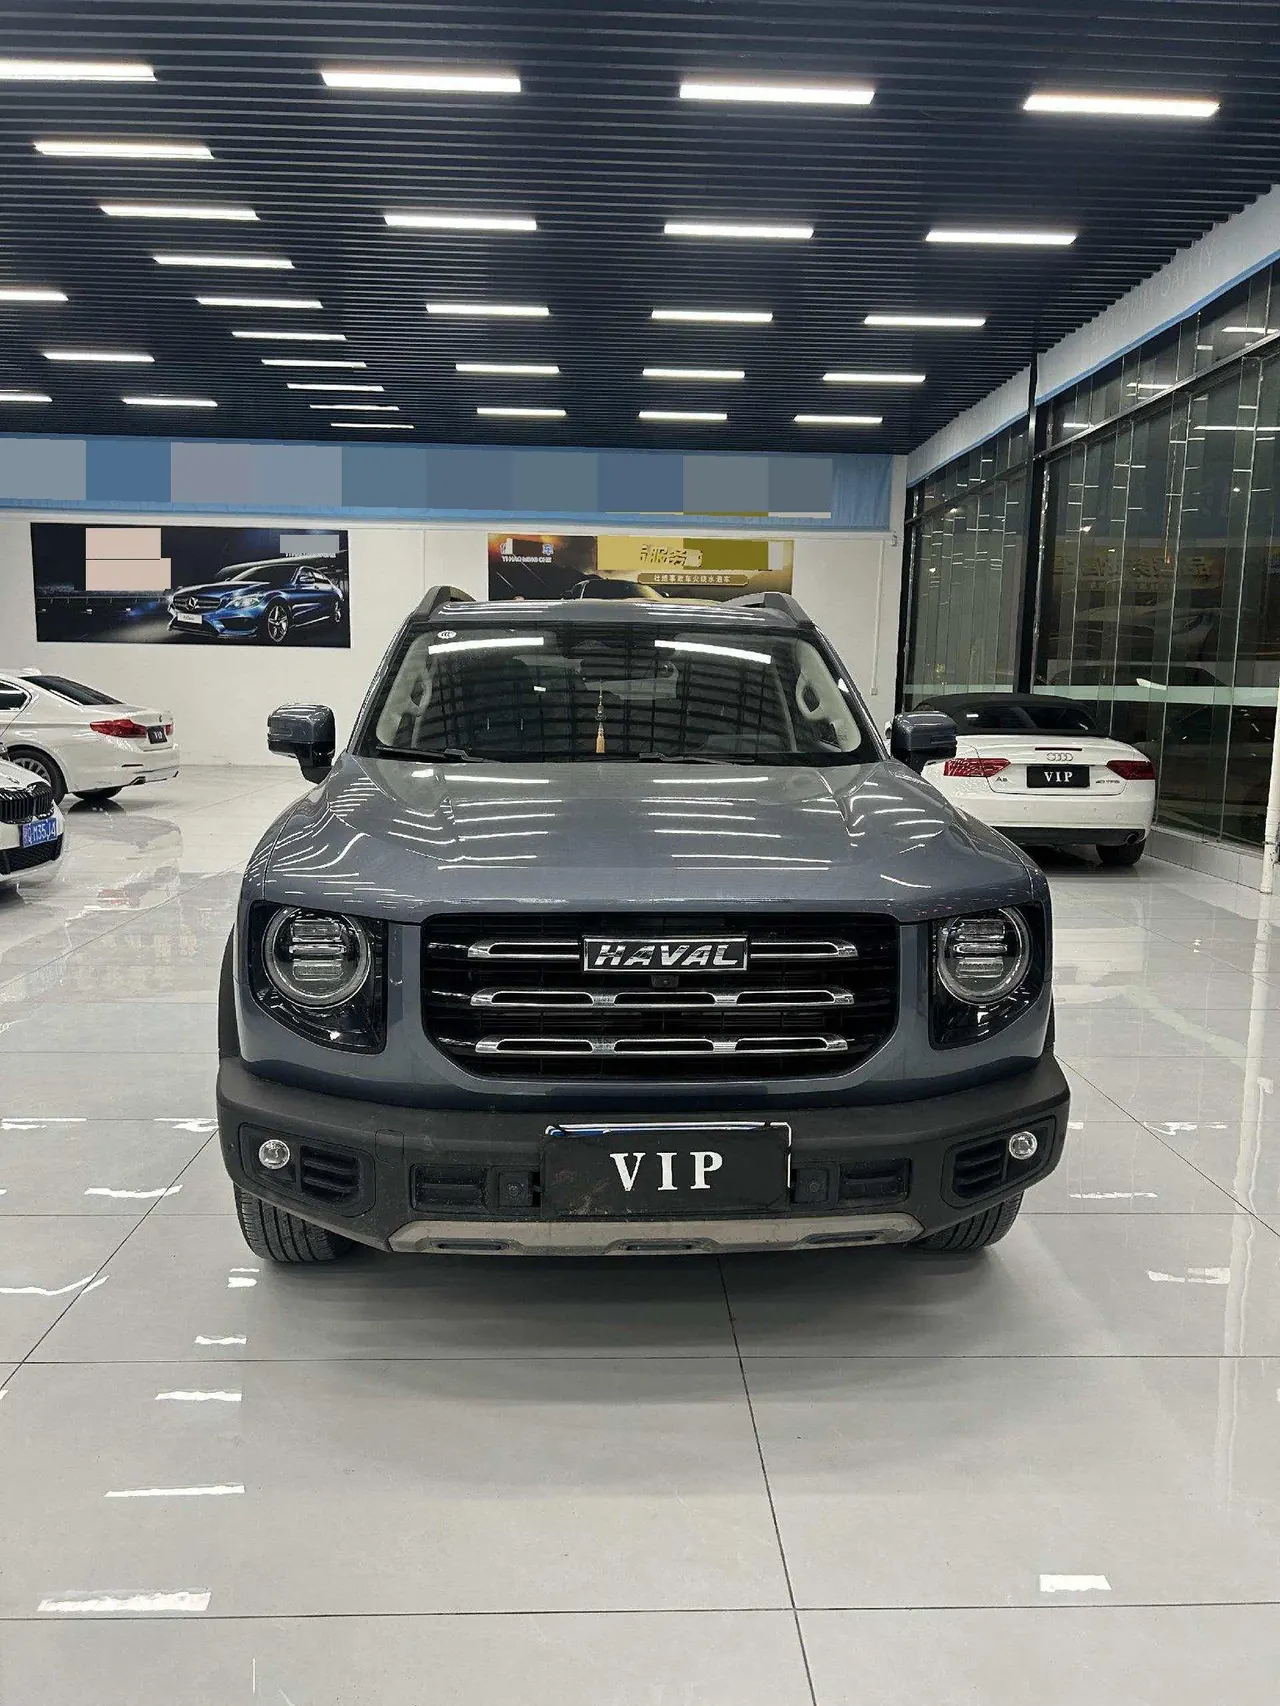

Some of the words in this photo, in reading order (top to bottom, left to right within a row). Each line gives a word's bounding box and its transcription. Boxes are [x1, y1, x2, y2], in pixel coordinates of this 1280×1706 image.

[1043, 771, 1073, 783] VIP
[594, 944, 738, 966] HAVAL
[609, 1151, 723, 1192] VIP
